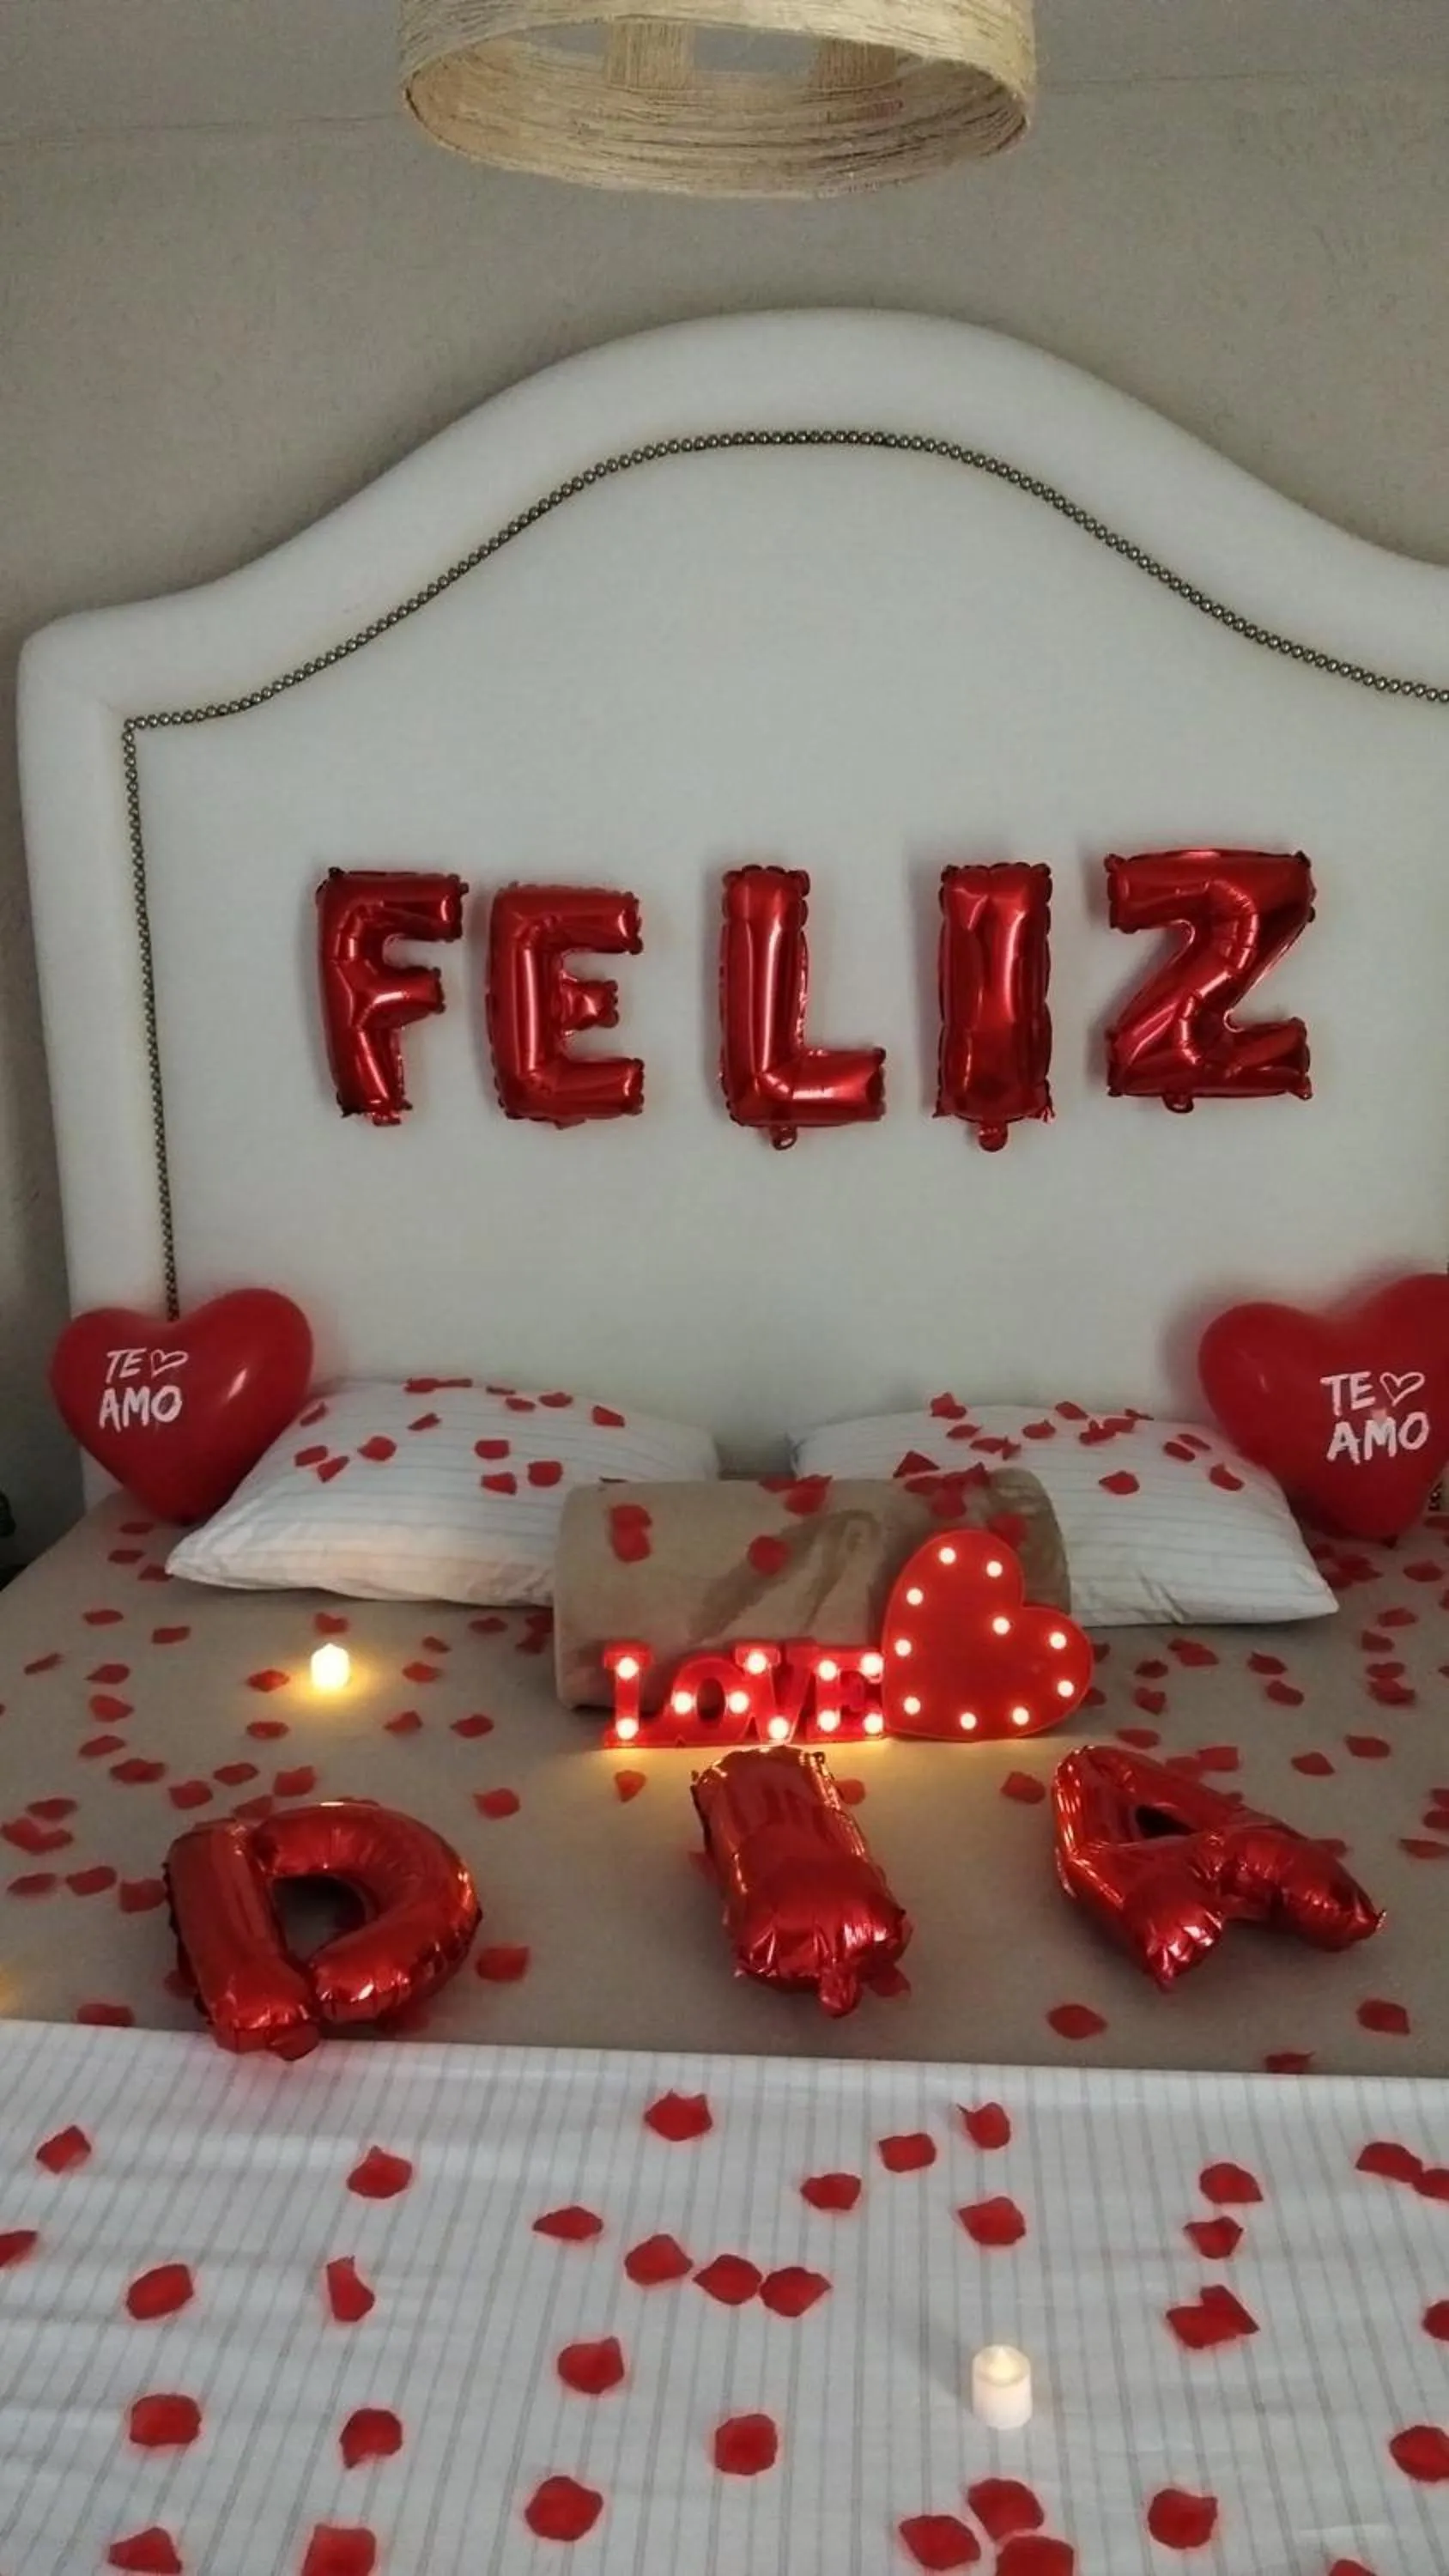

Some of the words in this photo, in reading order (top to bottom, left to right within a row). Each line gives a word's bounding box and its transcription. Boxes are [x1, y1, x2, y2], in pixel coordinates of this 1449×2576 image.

[317, 848, 1317, 1151] FELIZ
[106, 1348, 147, 1384] TE
[100, 1385, 183, 1432] AMO
[1320, 1371, 1376, 1416] TE
[1327, 1412, 1429, 1465] AMO
[603, 1639, 884, 1746] LOVE
[164, 1745, 1385, 2060] DIA
